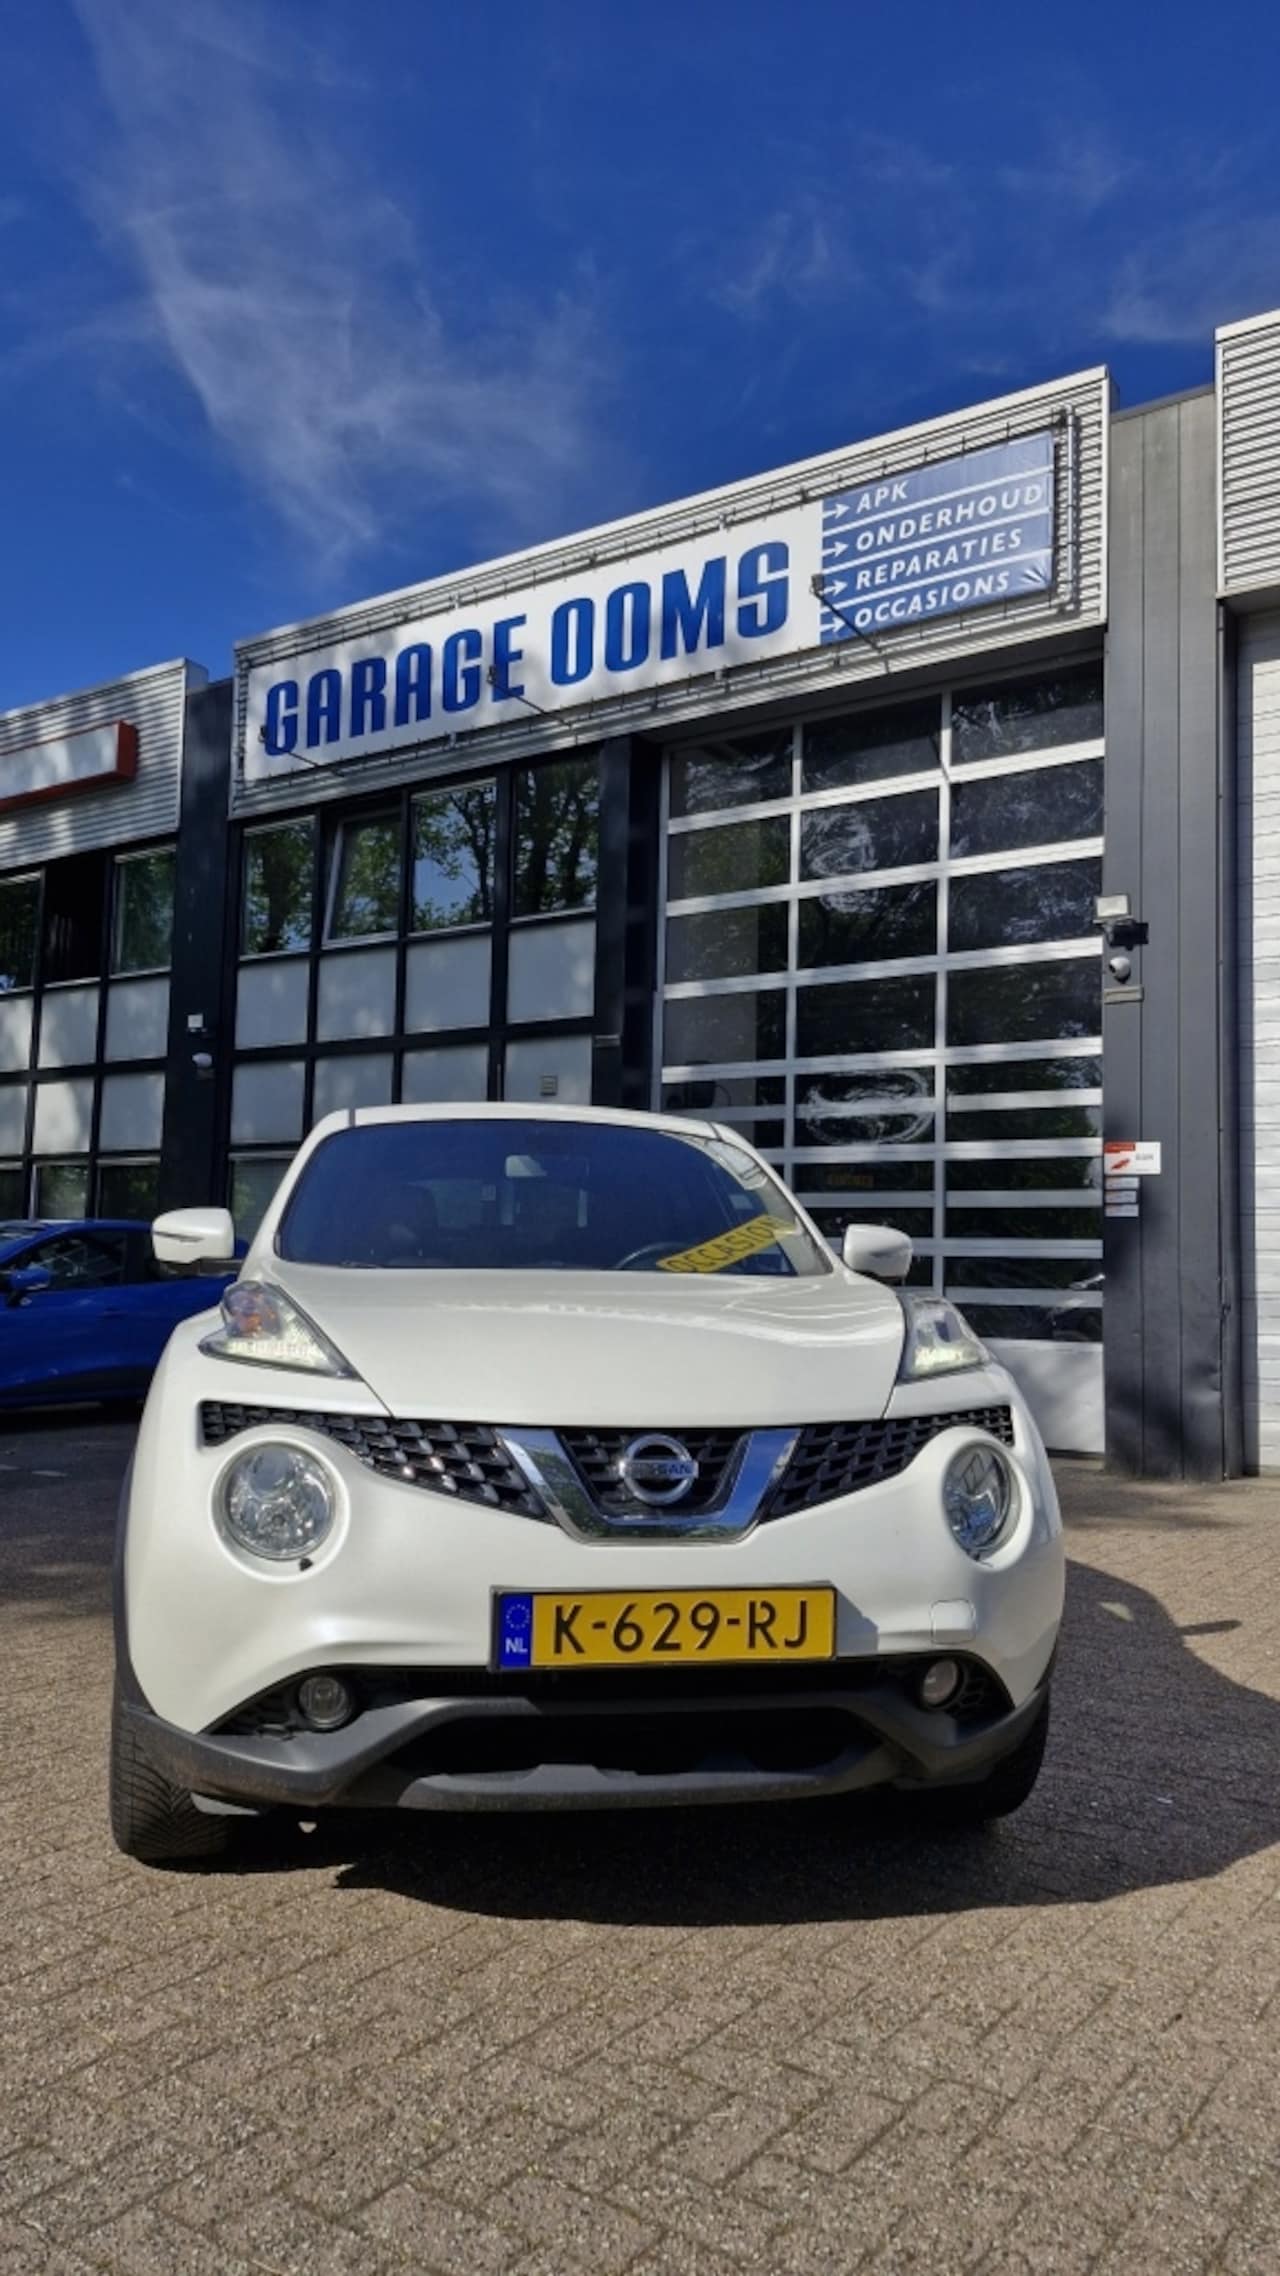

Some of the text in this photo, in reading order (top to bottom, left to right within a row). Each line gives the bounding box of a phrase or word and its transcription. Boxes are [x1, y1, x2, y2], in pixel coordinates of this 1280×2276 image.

[855, 483, 1044, 552] ONDERHOUD
[856, 481, 909, 514] APK
[855, 528, 1023, 590] REPARATIES
[853, 571, 1010, 628] OCCASIONS
[264, 541, 790, 757] GARAGE OOMS
[628, 1463, 694, 1476] SSAN
[504, 1637, 528, 1654] NL
[553, 1600, 808, 1655] K-629-RJ
